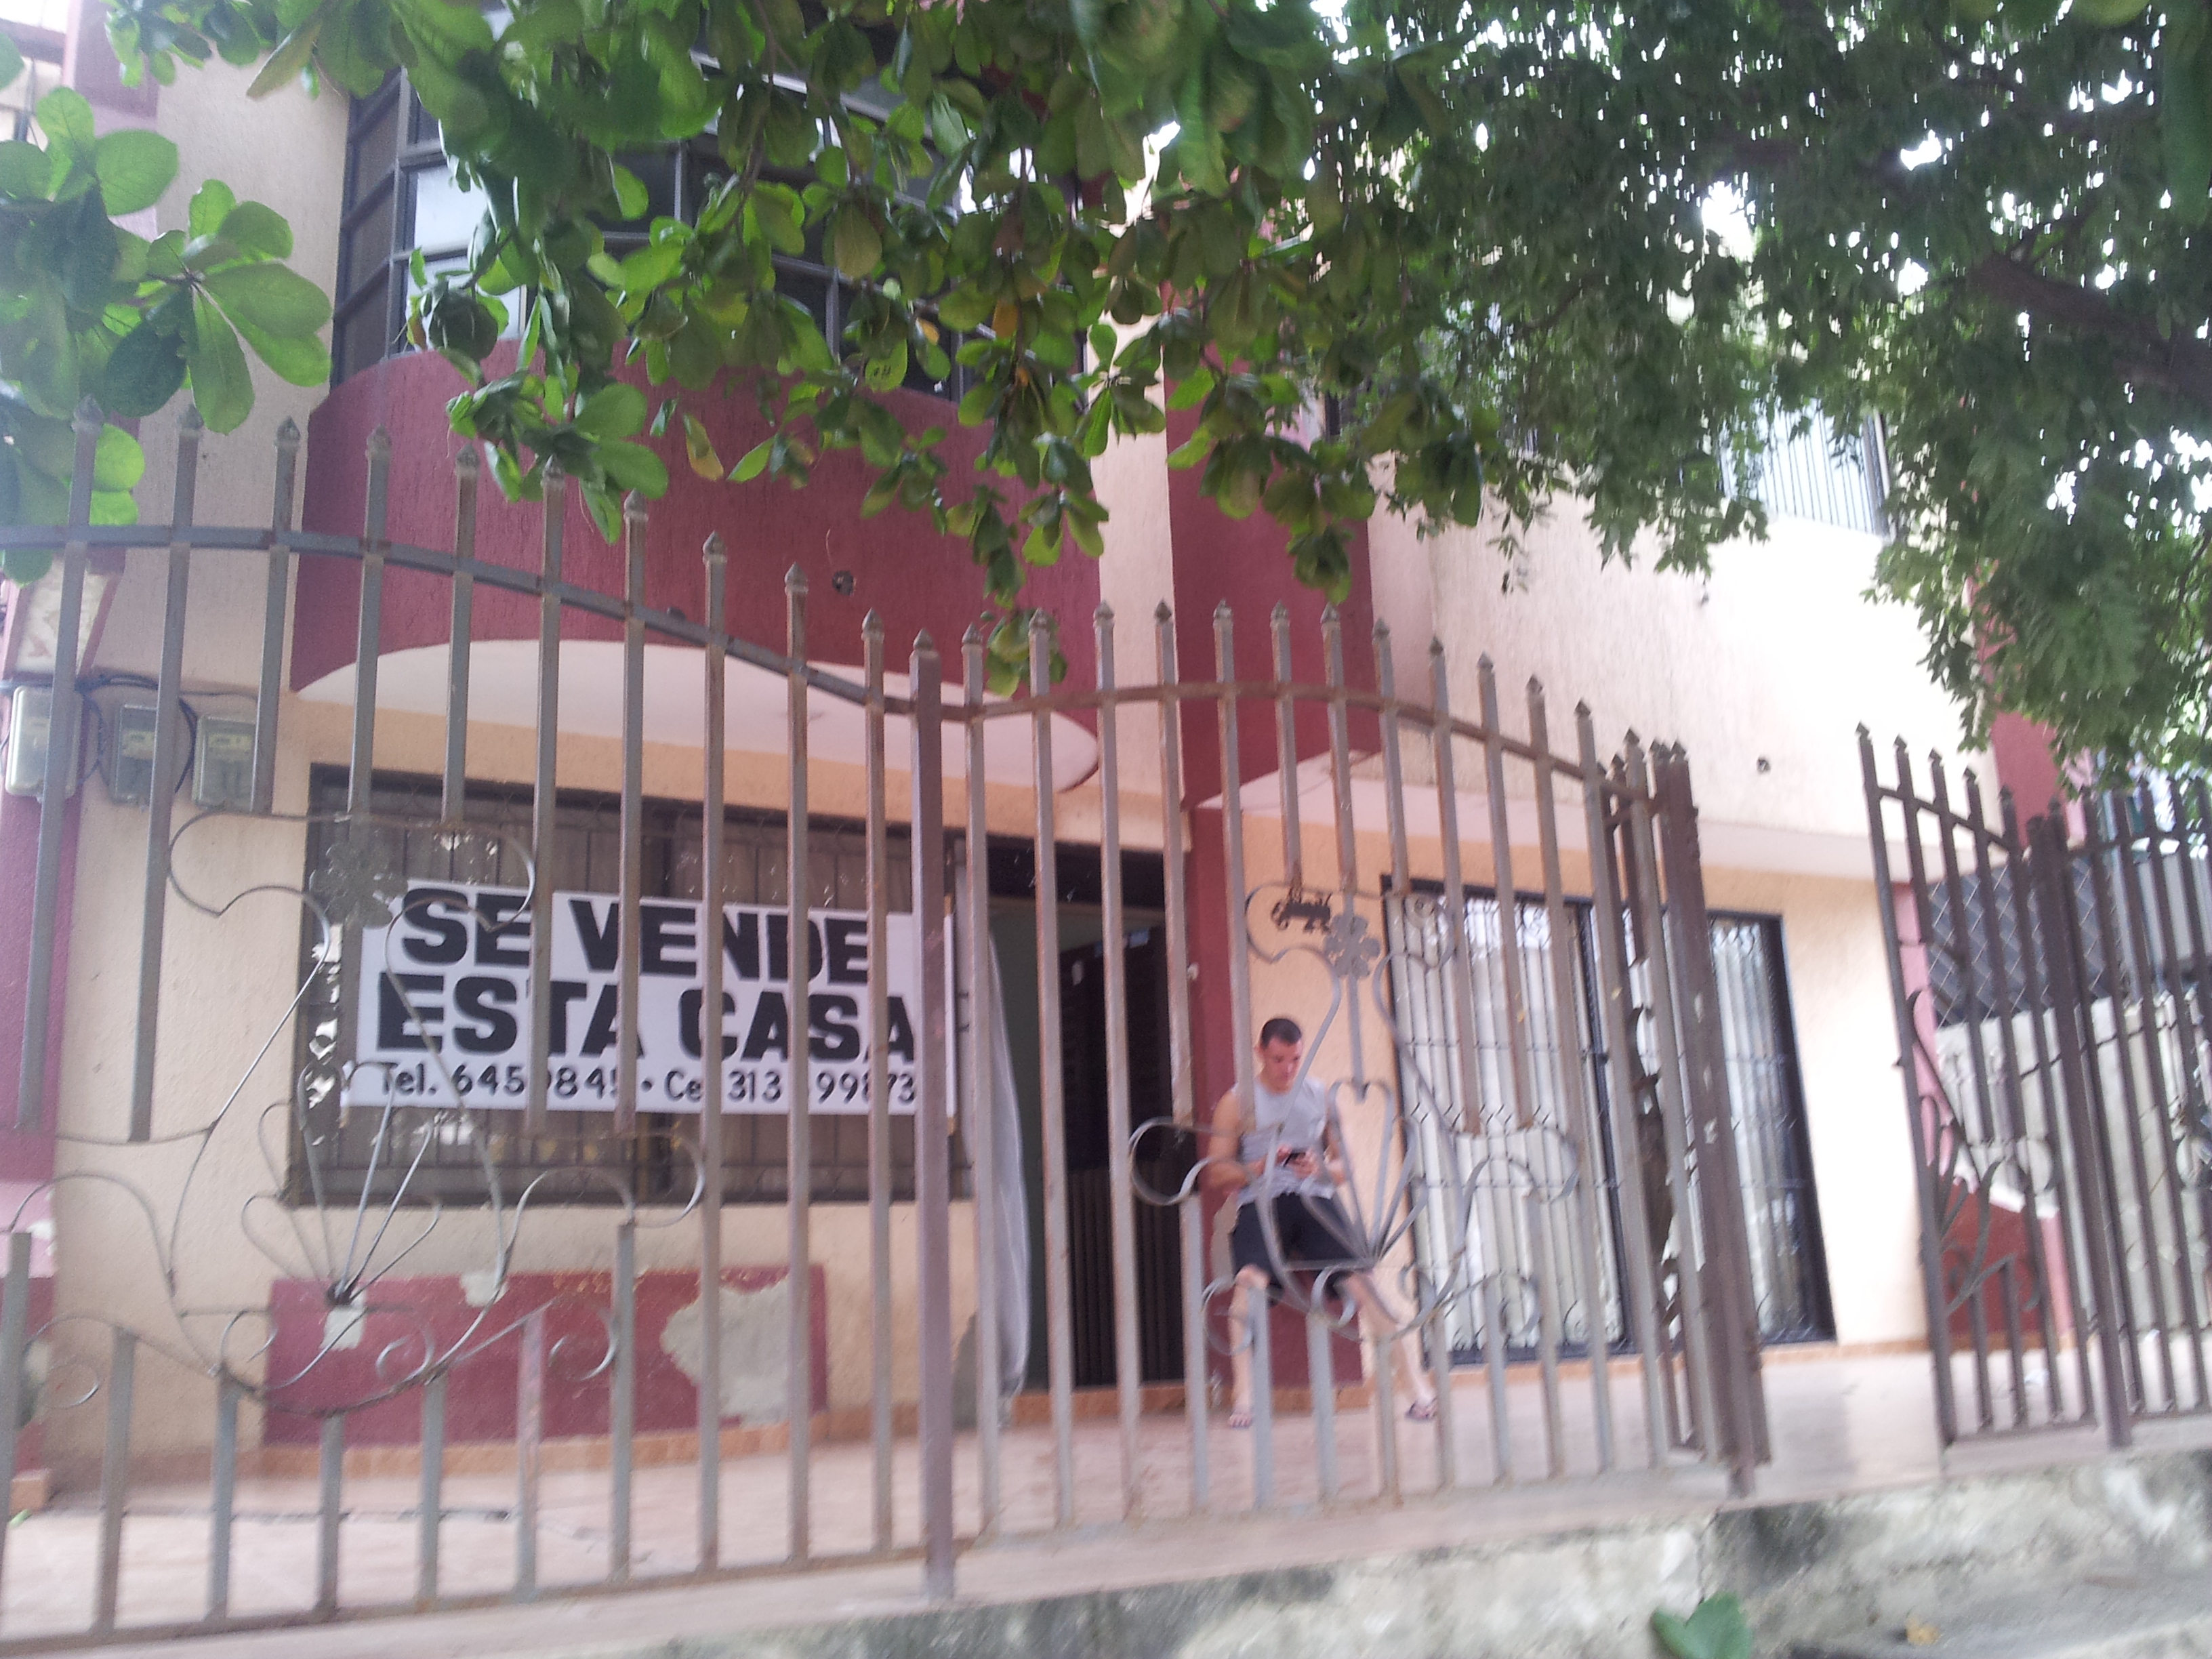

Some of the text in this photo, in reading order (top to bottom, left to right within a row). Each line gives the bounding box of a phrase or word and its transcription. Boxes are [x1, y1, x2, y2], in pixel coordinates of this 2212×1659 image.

[402, 886, 874, 986] SE VENDE
[377, 972, 916, 1063] ESTA CASA
